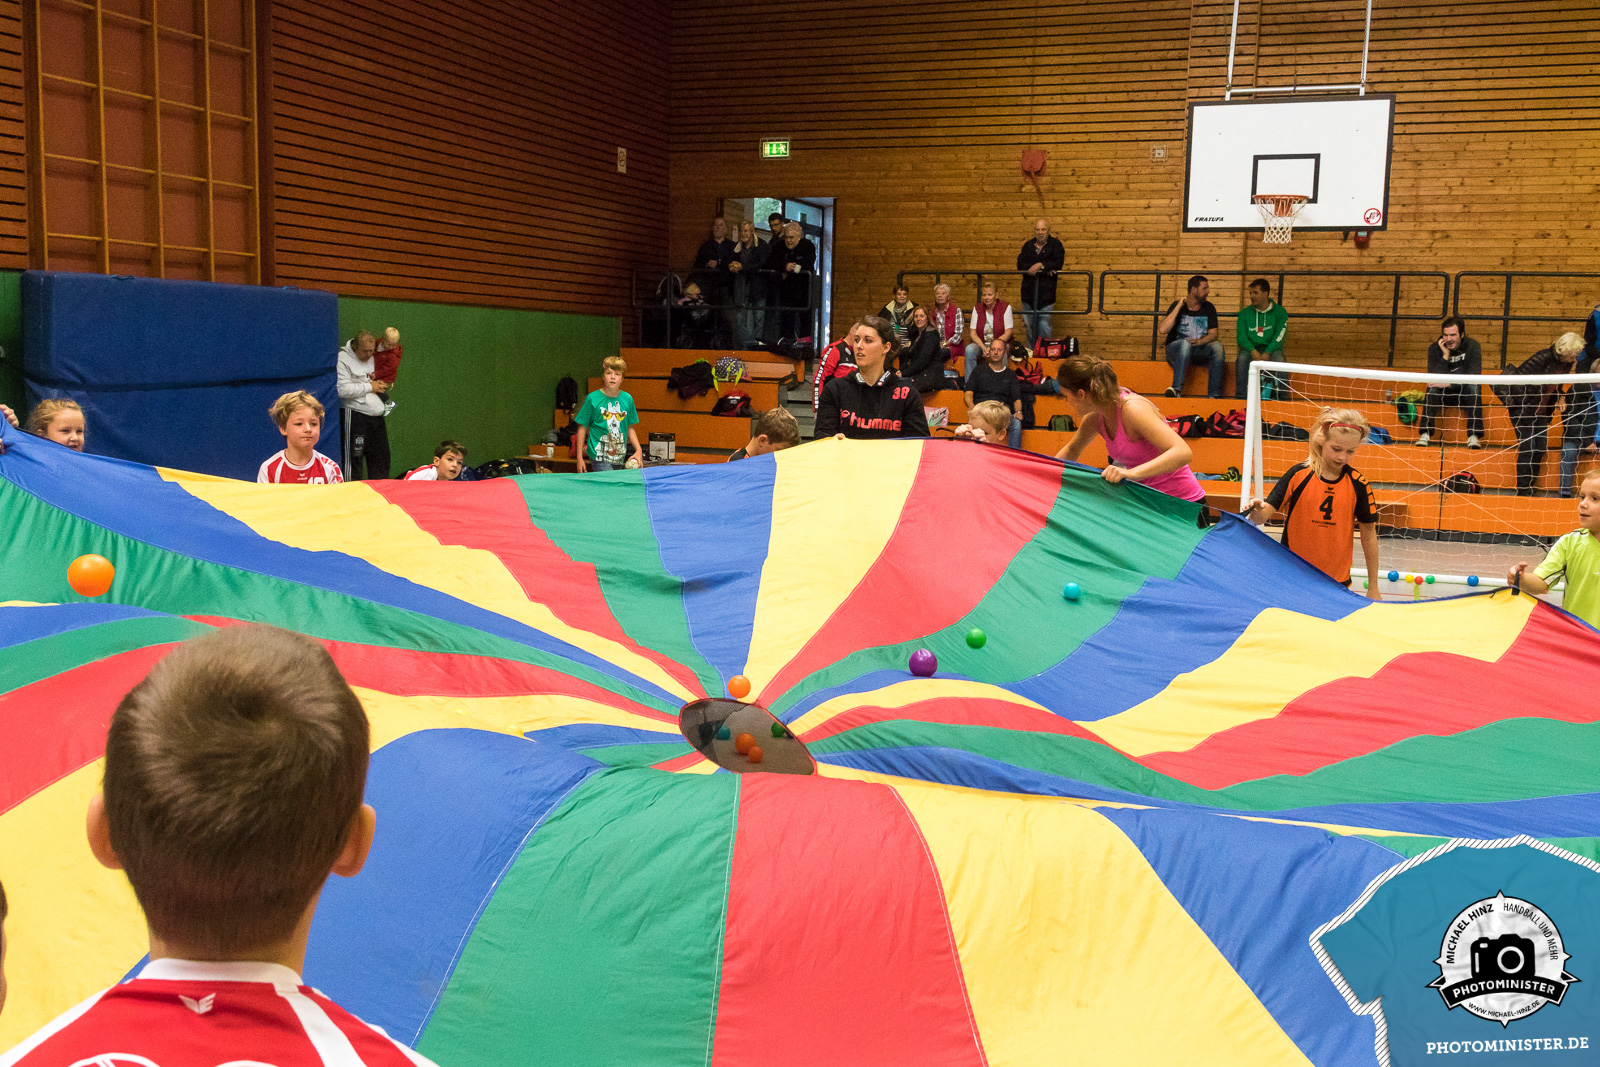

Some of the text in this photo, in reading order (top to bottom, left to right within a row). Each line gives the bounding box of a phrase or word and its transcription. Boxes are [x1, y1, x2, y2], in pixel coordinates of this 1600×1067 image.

[892, 386, 910, 400] 38
[849, 411, 903, 432] humme
[1319, 495, 1334, 520] 4
